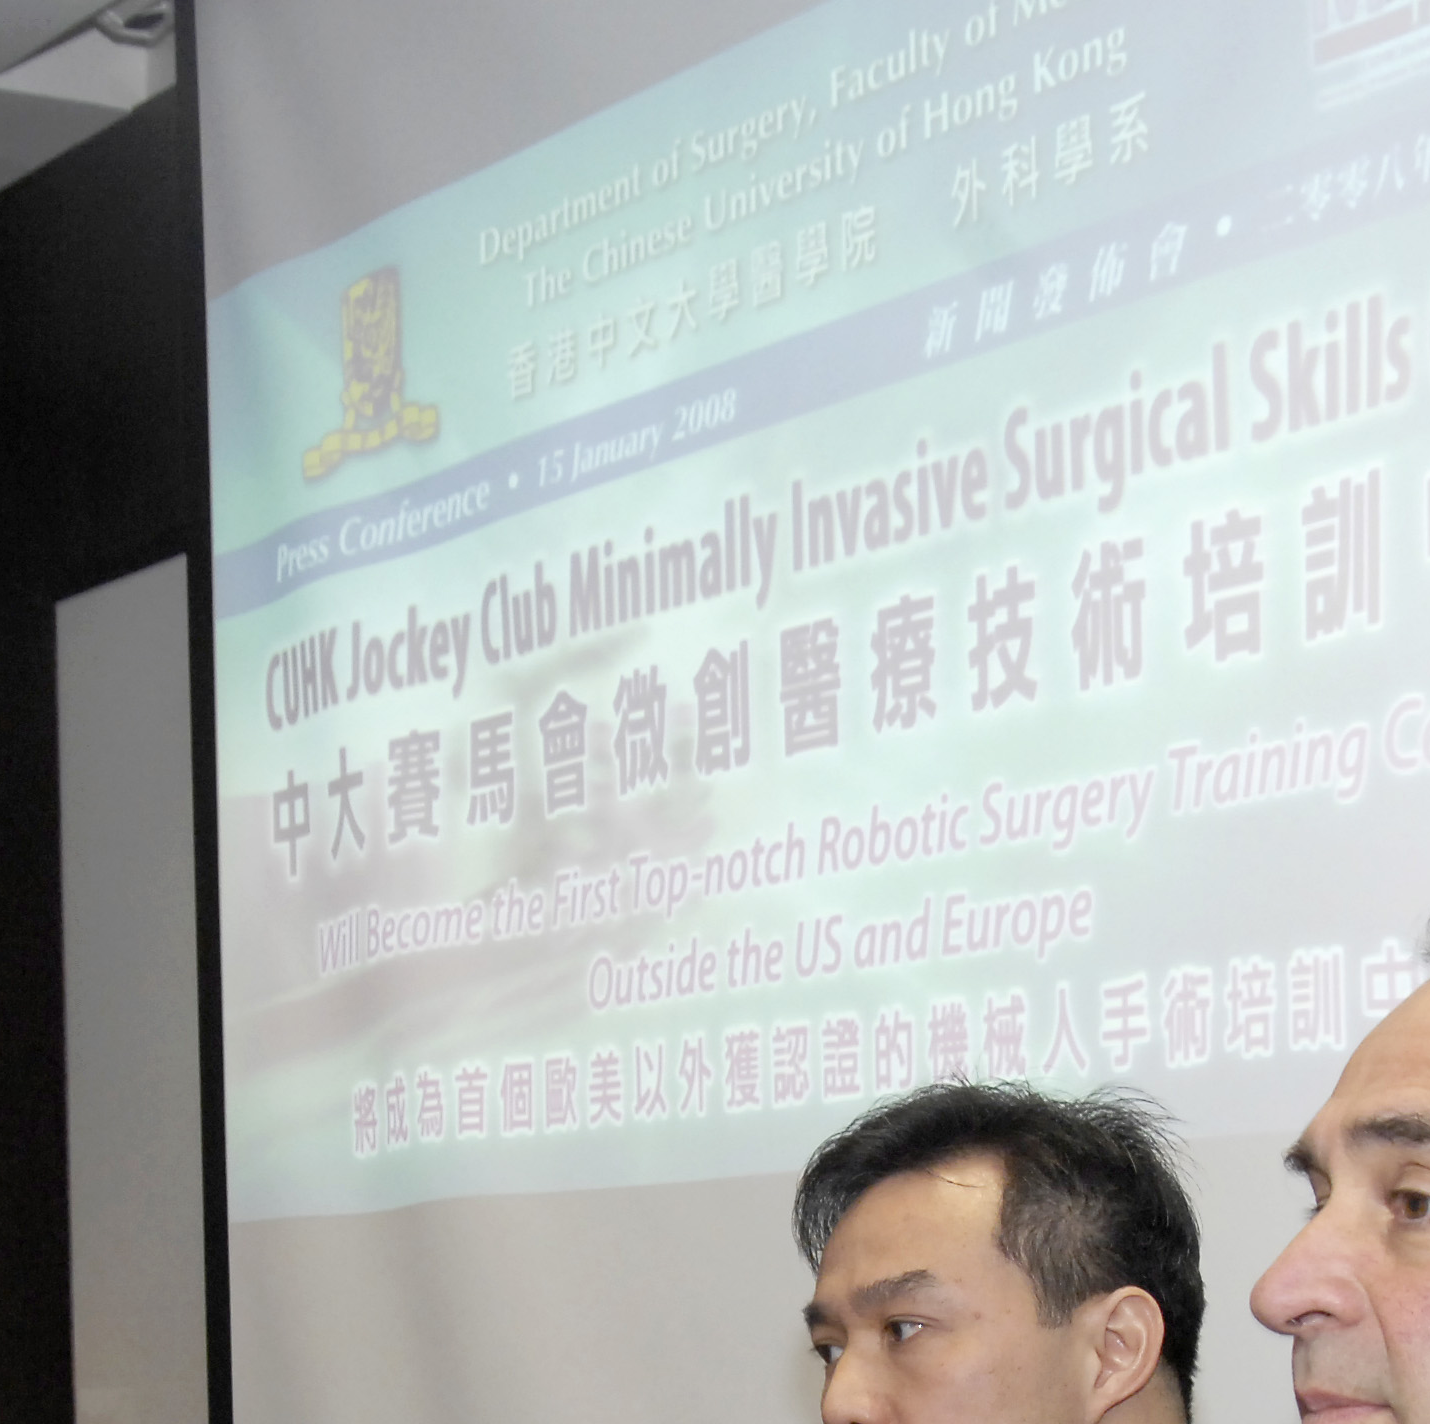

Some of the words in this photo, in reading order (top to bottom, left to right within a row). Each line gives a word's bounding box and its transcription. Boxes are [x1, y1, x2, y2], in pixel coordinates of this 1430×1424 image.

[478, 165, 642, 265] Department
[651, 138, 684, 188] of
[691, 94, 818, 171] Surgery,
[829, 28, 951, 107] Faculty
[964, 0, 999, 46] of
[506, 204, 877, 401] 香港中文大學醫學院
[951, 90, 1150, 228] 外科學系
[522, 261, 572, 307] The
[581, 212, 693, 282] Chinese
[704, 138, 864, 231] University
[876, 104, 912, 158] of
[923, 72, 1019, 140] Hong
[1032, 26, 1128, 95] Kong
[922, 220, 1188, 359] 新聞發佈會
[264, 625, 340, 733] CUHK
[345, 603, 472, 700] Jockey
[480, 560, 558, 665] Club
[570, 492, 778, 639] Minimally
[790, 437, 990, 573] Invasive
[1003, 341, 1231, 514] Surgical
[1249, 292, 1412, 444] Skills
[275, 535, 332, 583] Press
[337, 480, 491, 558] Conference
[536, 448, 565, 488] 15
[569, 421, 666, 481] January
[671, 386, 739, 442] 2008
[317, 915, 361, 974] Will
[364, 904, 482, 960] Become
[491, 881, 544, 937] the
[552, 864, 621, 927] First
[627, 821, 806, 919] Top-notch
[817, 793, 970, 875] Robotic
[978, 769, 1155, 850] Surgery
[1167, 722, 1369, 812] Training
[587, 937, 717, 1011] Outside
[726, 927, 784, 990] the
[793, 914, 844, 978] US
[853, 897, 932, 969] and
[941, 889, 1094, 959] Europe
